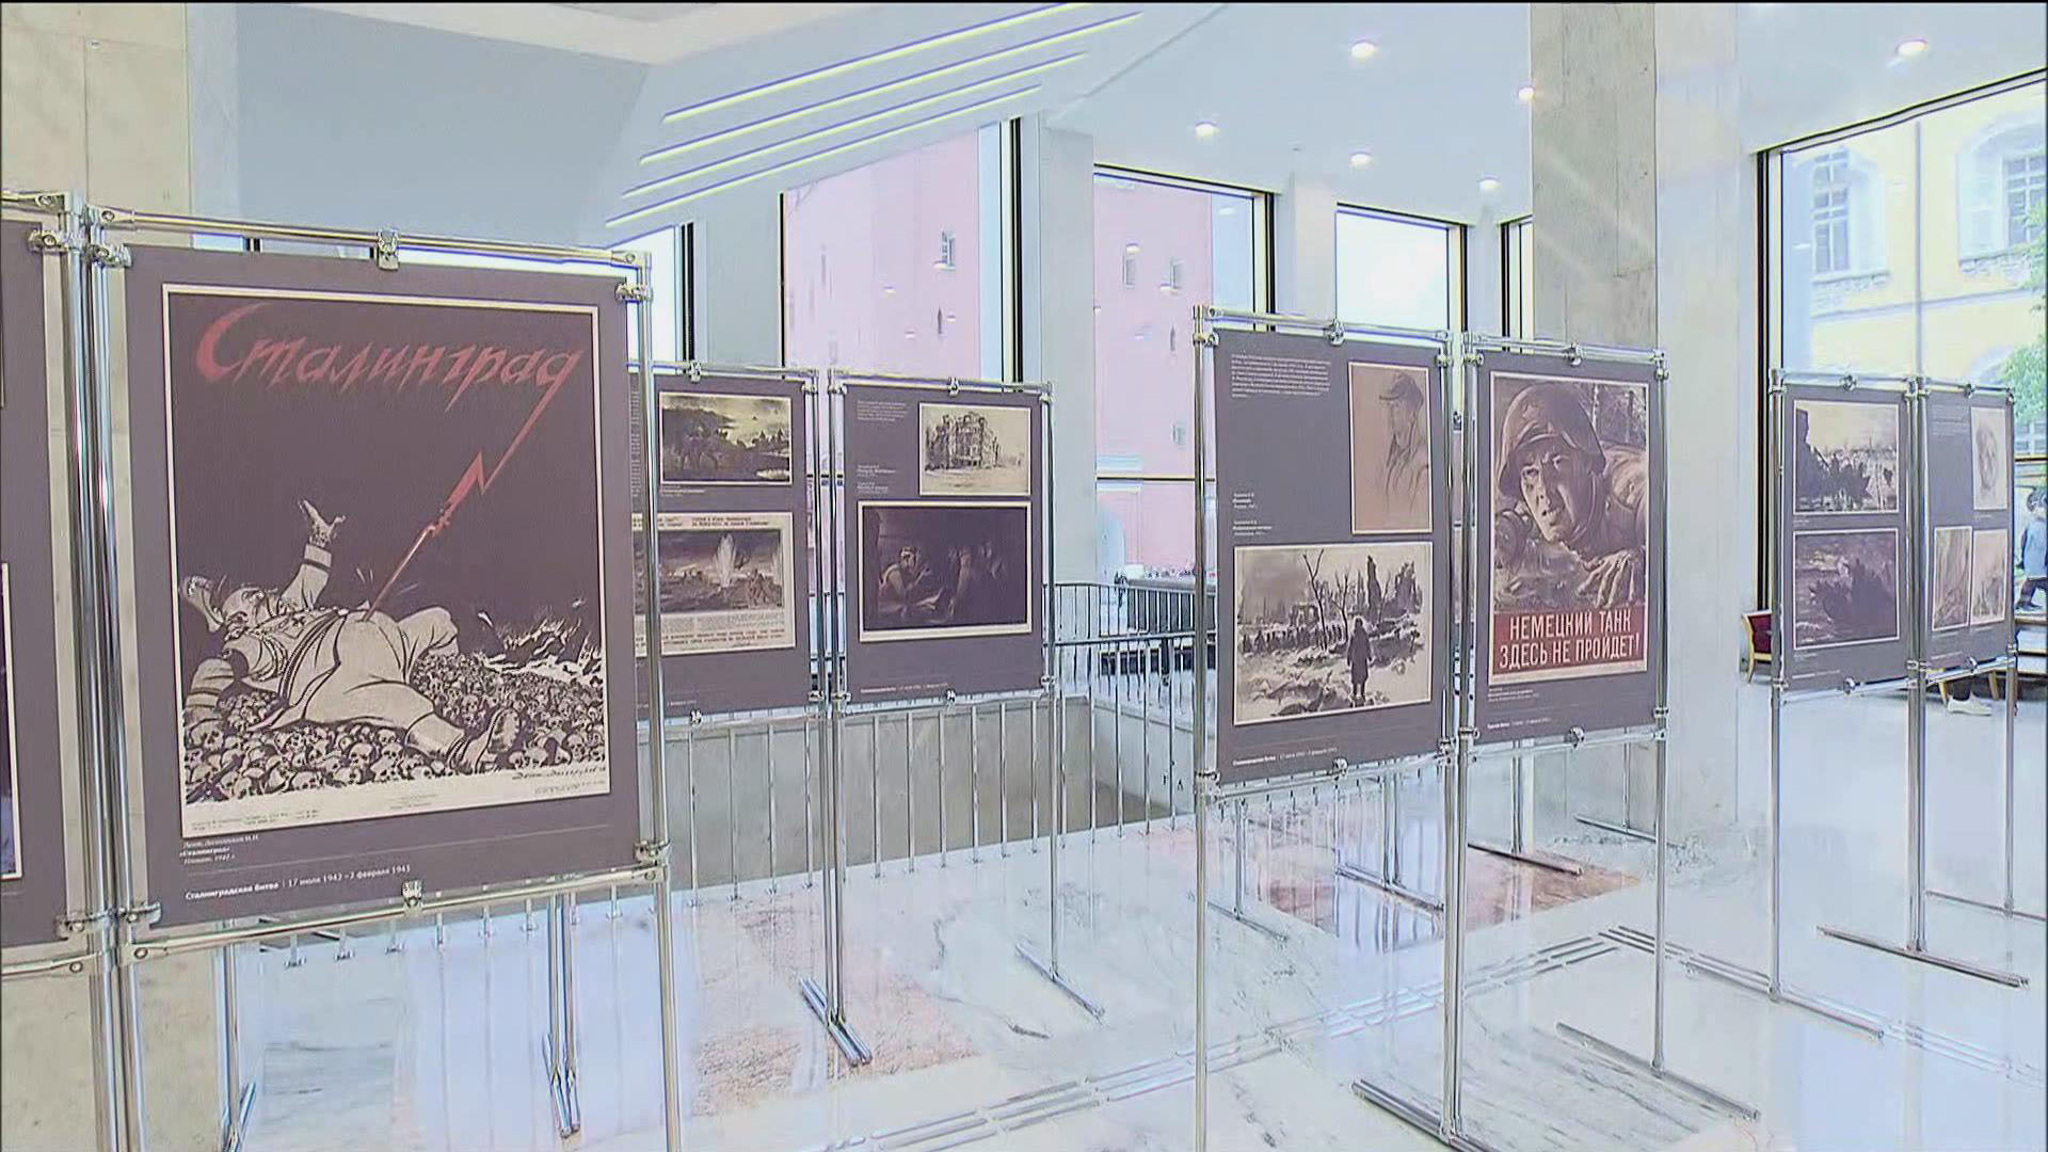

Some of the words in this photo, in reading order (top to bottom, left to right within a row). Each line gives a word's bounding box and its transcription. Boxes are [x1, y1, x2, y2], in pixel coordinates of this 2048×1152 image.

[196, 301, 584, 418] Сталинград
[1510, 610, 1593, 641] НЕМЕЦКИЙ
[1599, 609, 1631, 633] ТАНК
[1499, 642, 1548, 670] ЗДЕСЬ
[1552, 640, 1570, 664] НЕ
[1576, 632, 1640, 662] ПРОЙДЕТ!
[185, 886, 253, 900] Сталинградская
